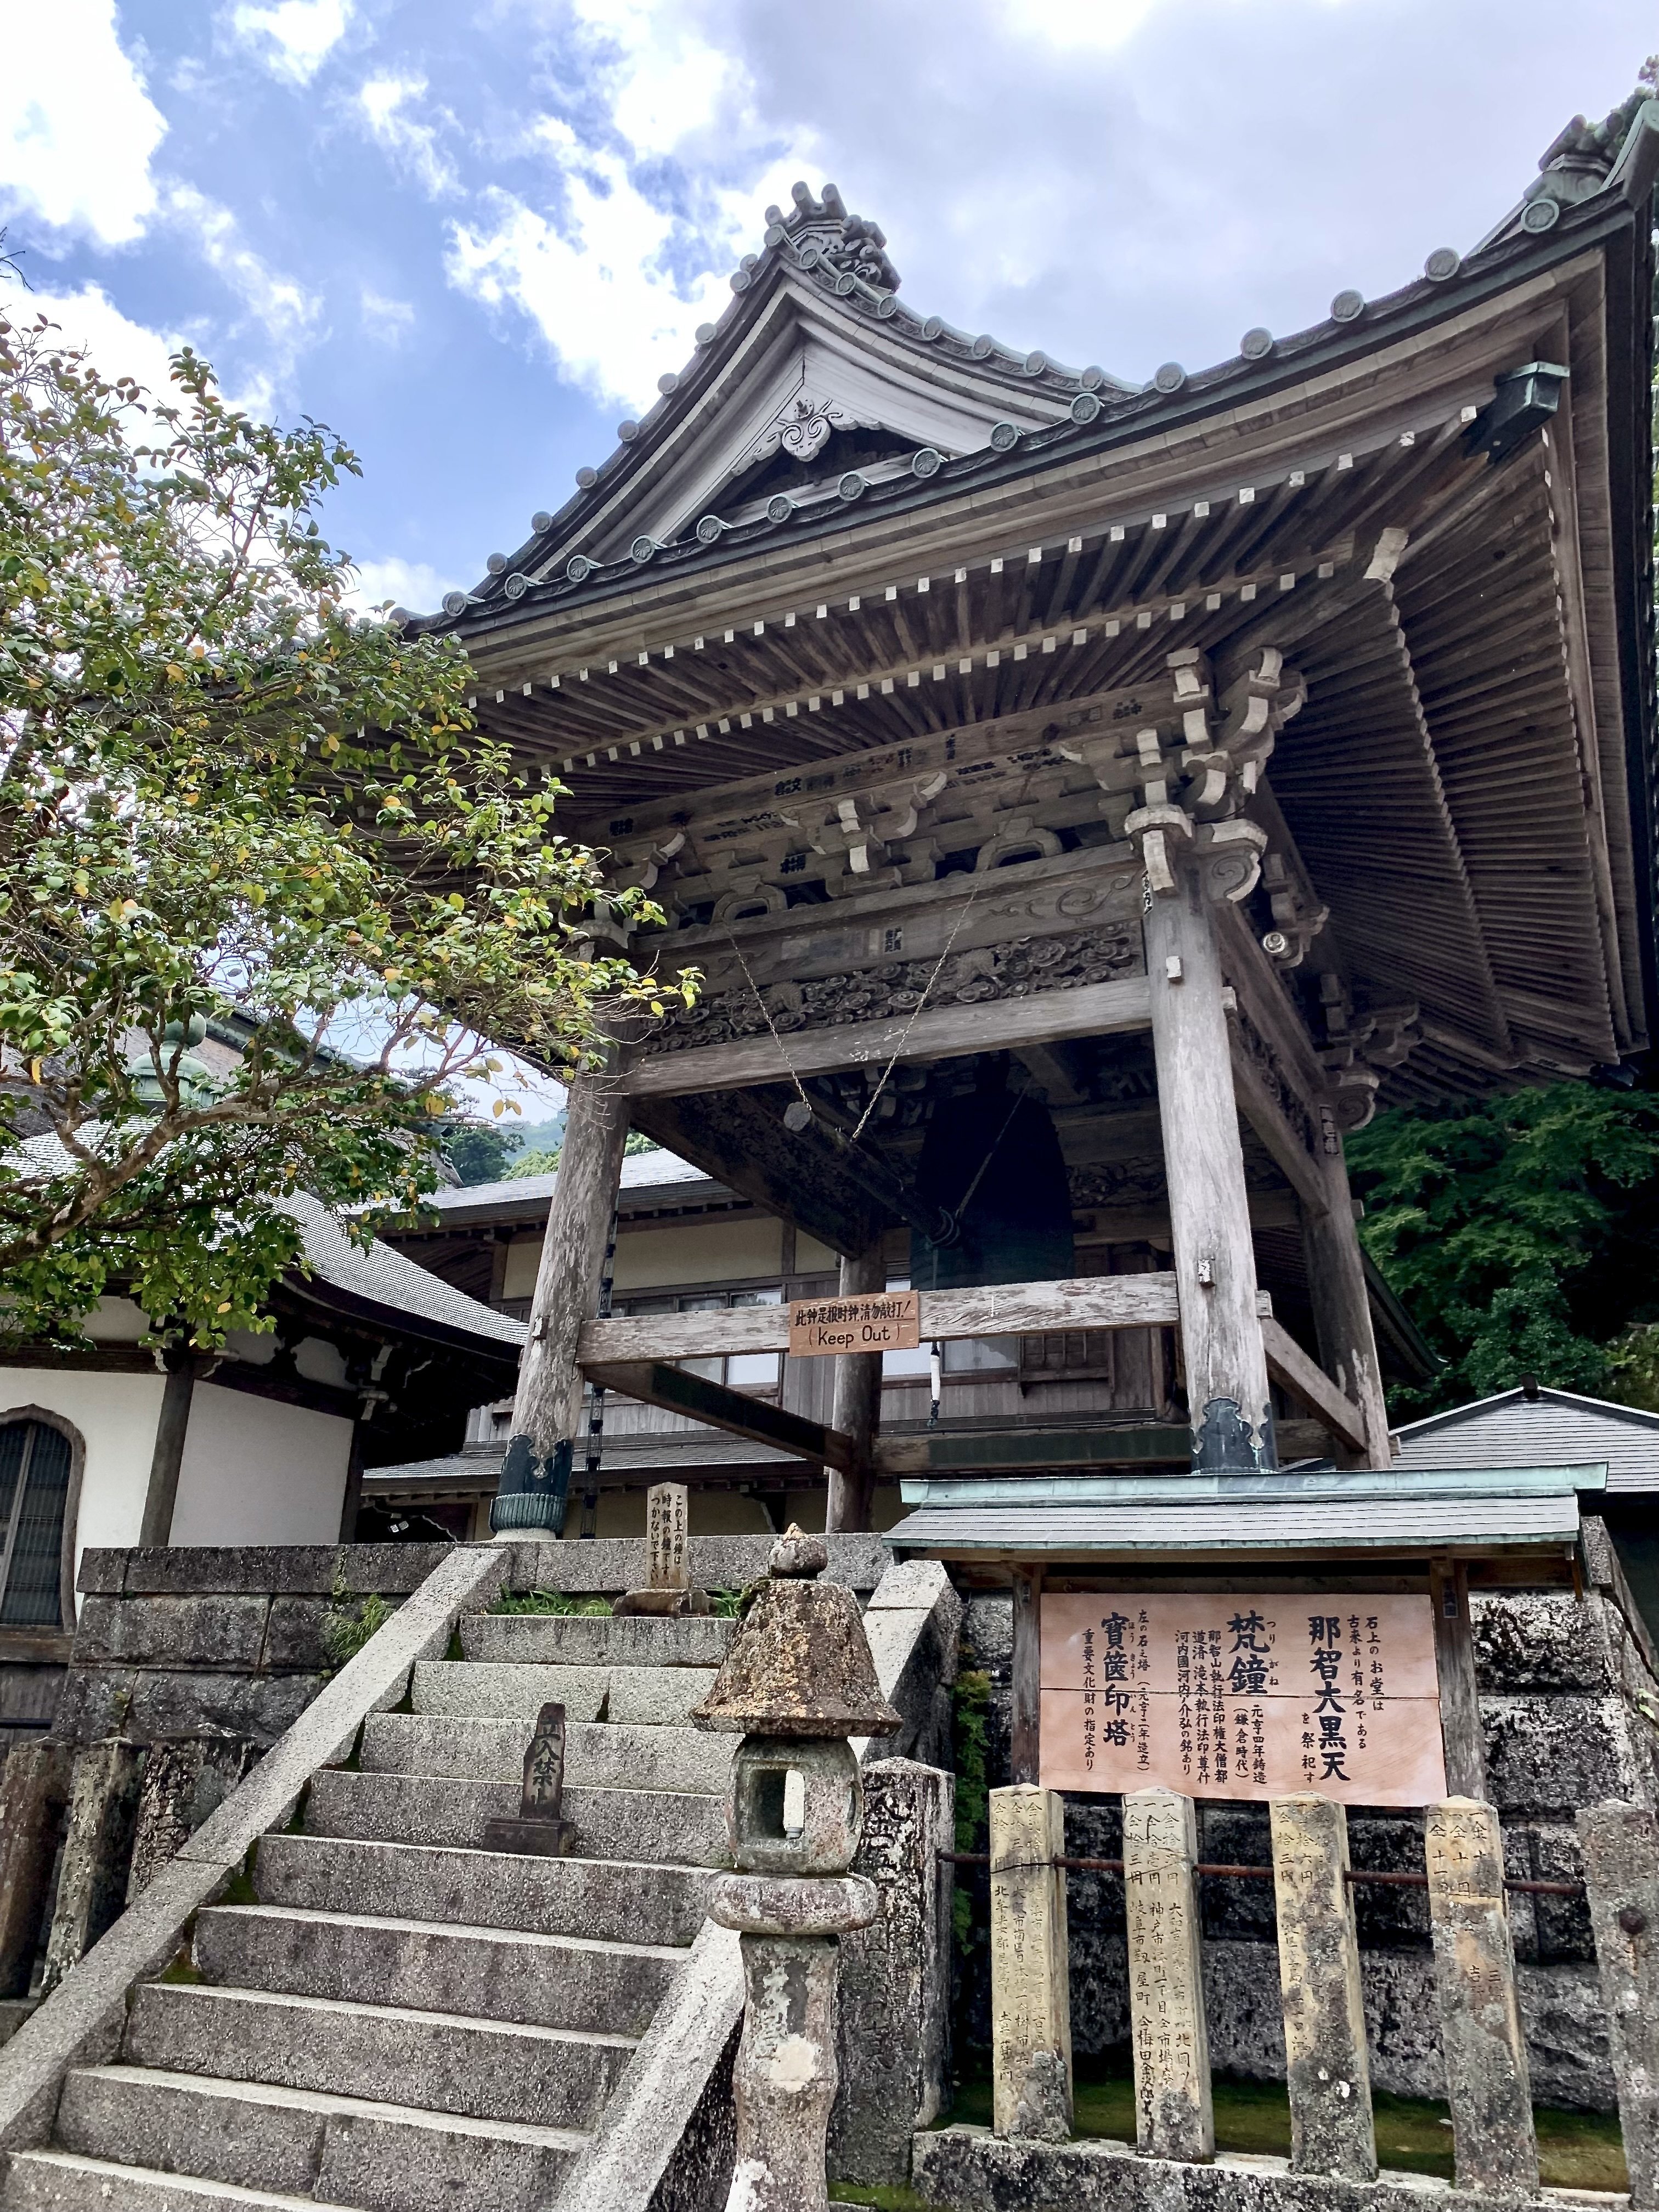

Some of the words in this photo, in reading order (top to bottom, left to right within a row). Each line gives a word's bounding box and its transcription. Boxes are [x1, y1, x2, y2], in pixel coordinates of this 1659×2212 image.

[1082, 1628, 1096, 1771] 重要文化財の指定あり
[1225, 1610, 1271, 1695] 梵鐘
[1308, 1615, 1351, 1781] 那智大黒天
[1347, 1615, 1367, 1748] 古来より有名である
[531, 1716, 561, 1805] 立入禁止
